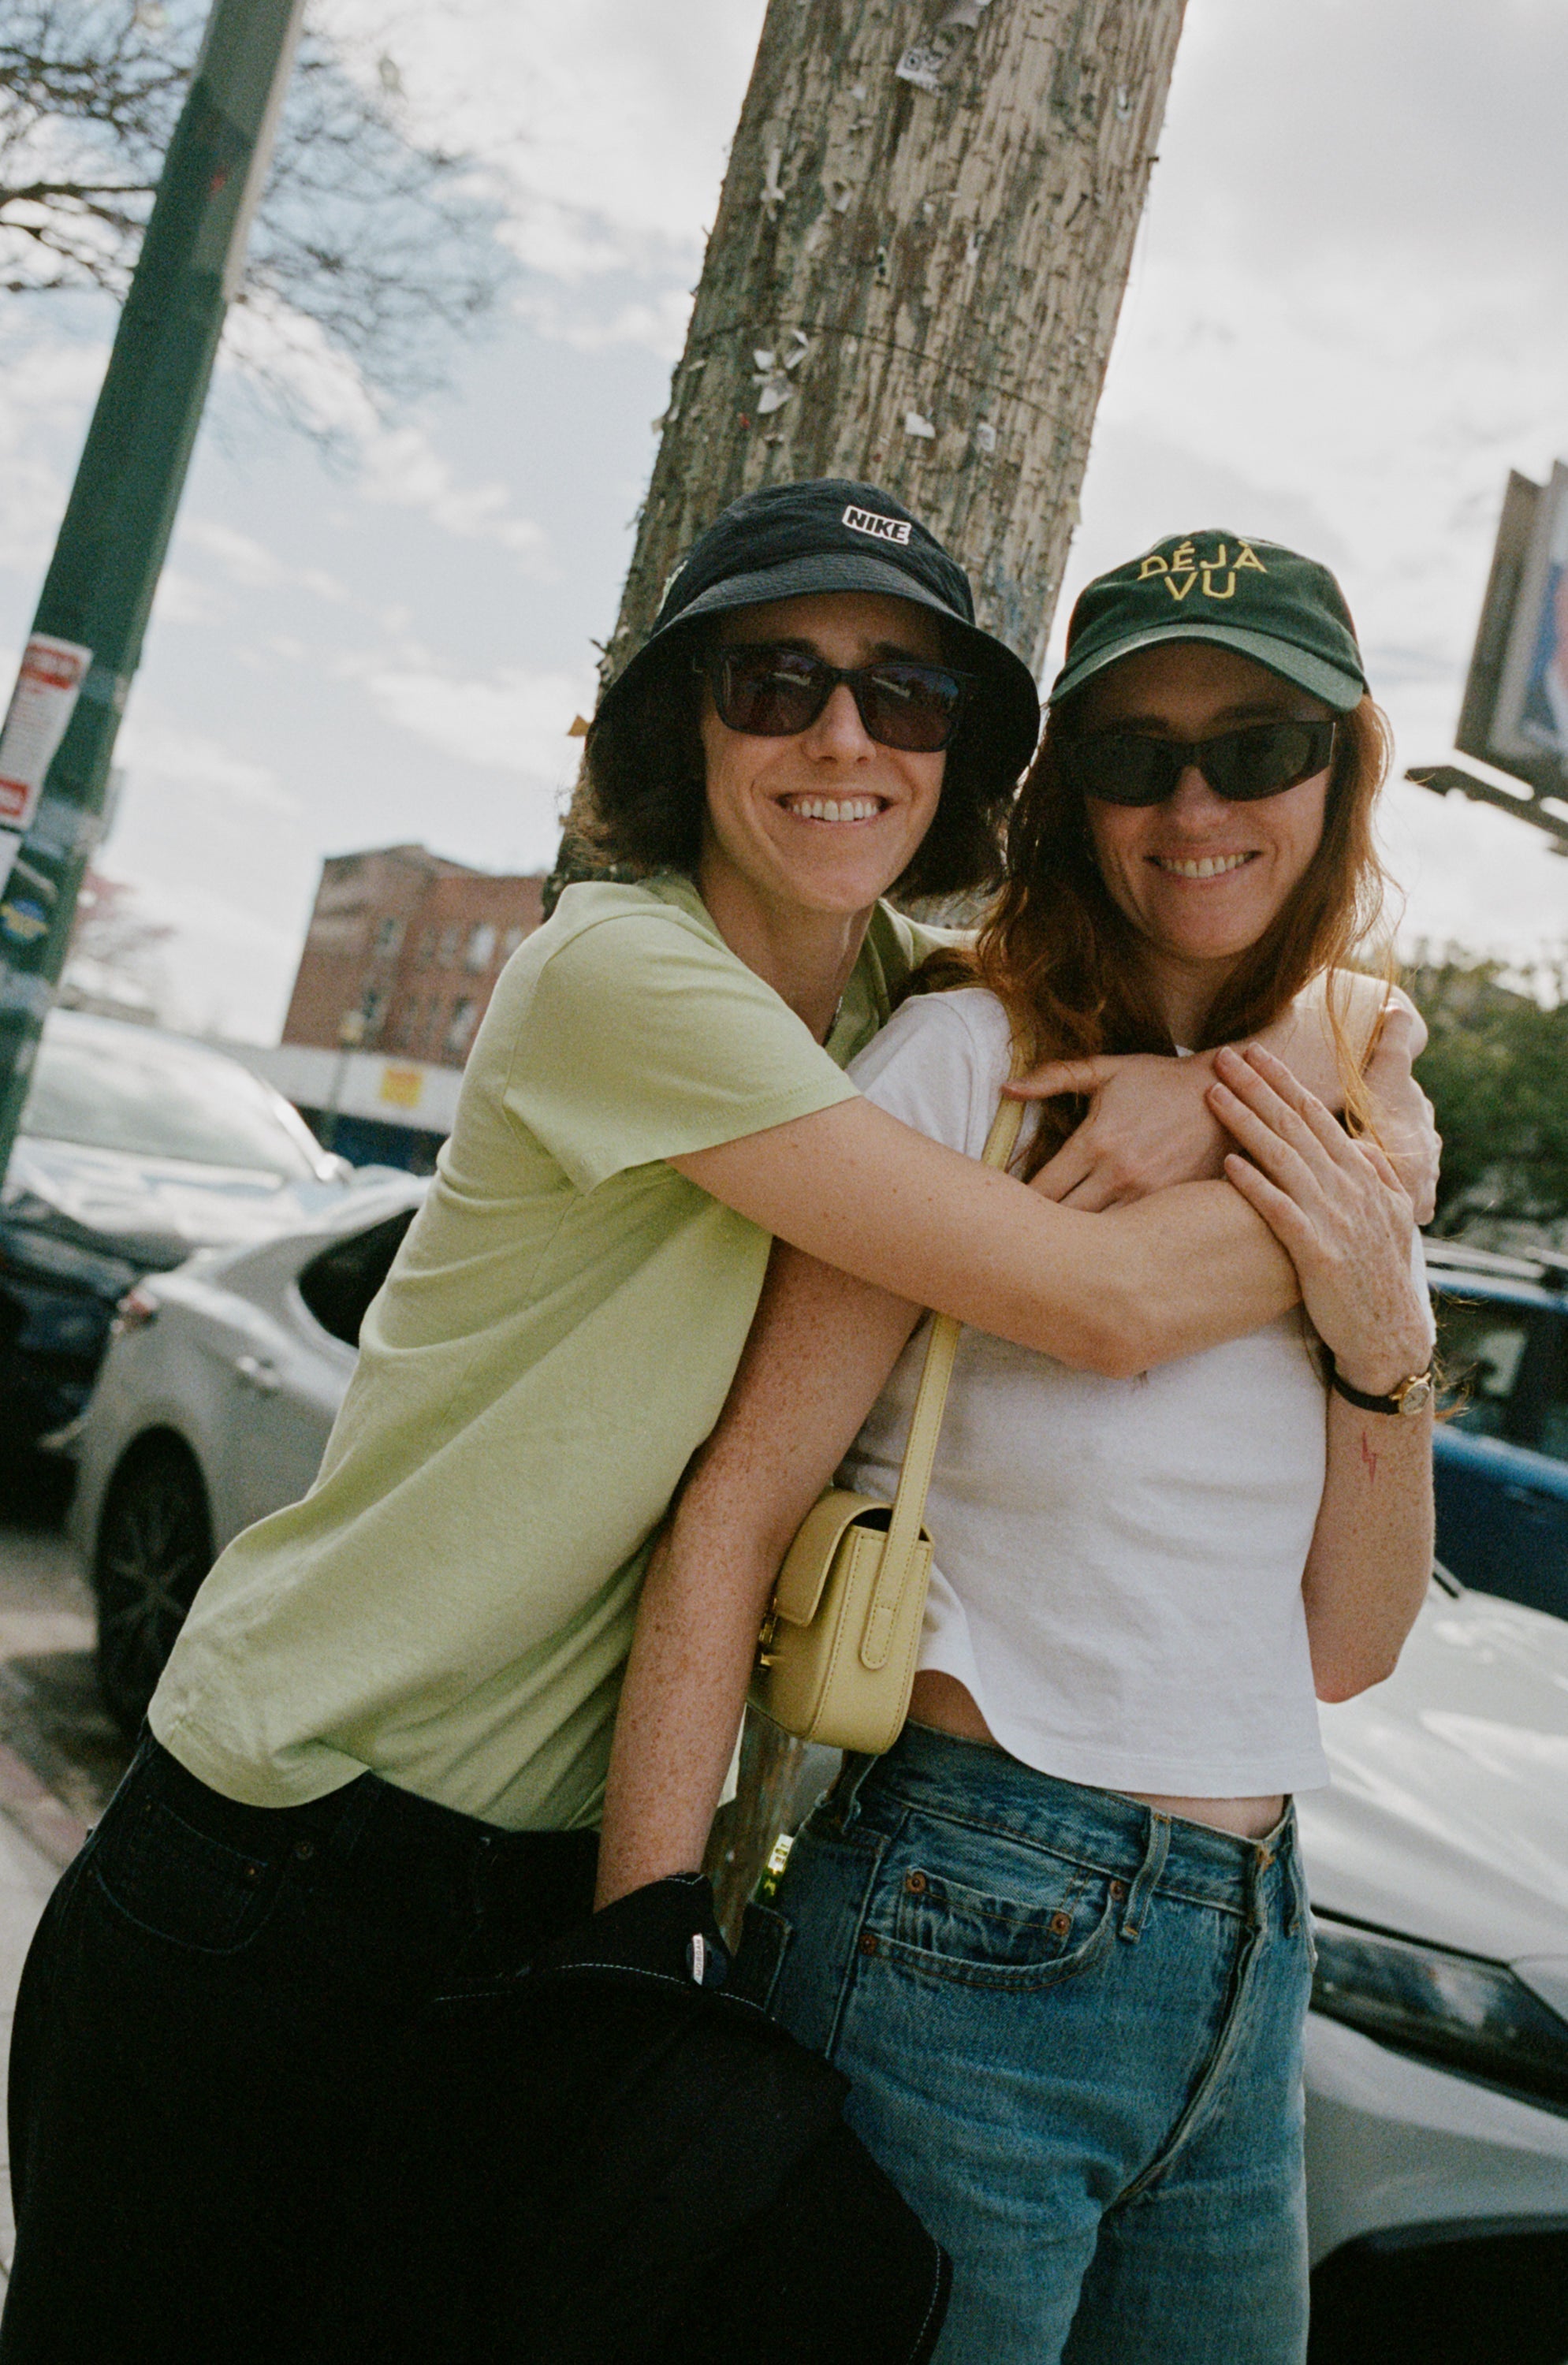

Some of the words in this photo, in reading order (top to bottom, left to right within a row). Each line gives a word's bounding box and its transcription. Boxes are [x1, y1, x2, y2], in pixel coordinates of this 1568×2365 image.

[847, 508, 907, 542] NIKE
[1137, 540, 1267, 580] DÉJÀ
[1164, 569, 1236, 601] VU
